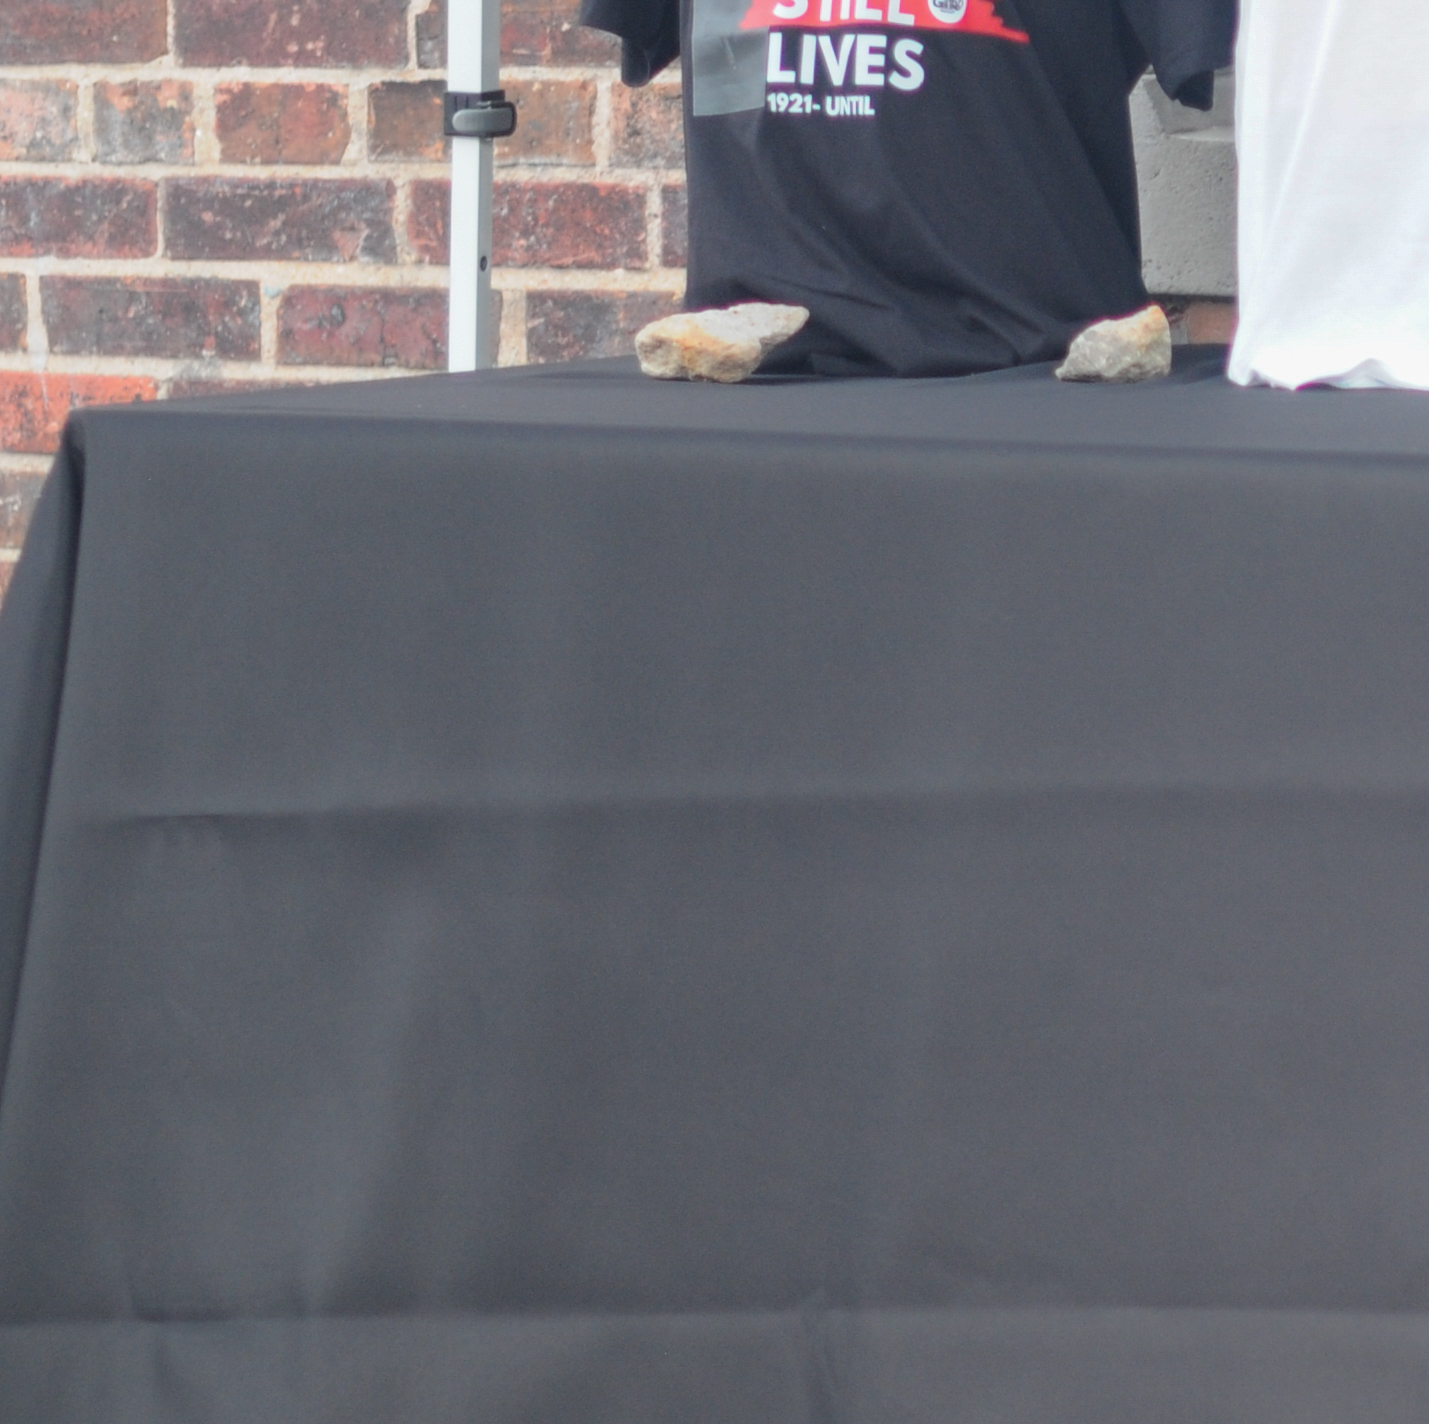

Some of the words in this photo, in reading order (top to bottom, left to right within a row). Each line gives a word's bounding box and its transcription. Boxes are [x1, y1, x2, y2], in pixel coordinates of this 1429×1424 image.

[766, 32, 924, 90] LIVES
[766, 92, 820, 114] 1921-
[826, 94, 875, 117] UNTIL
